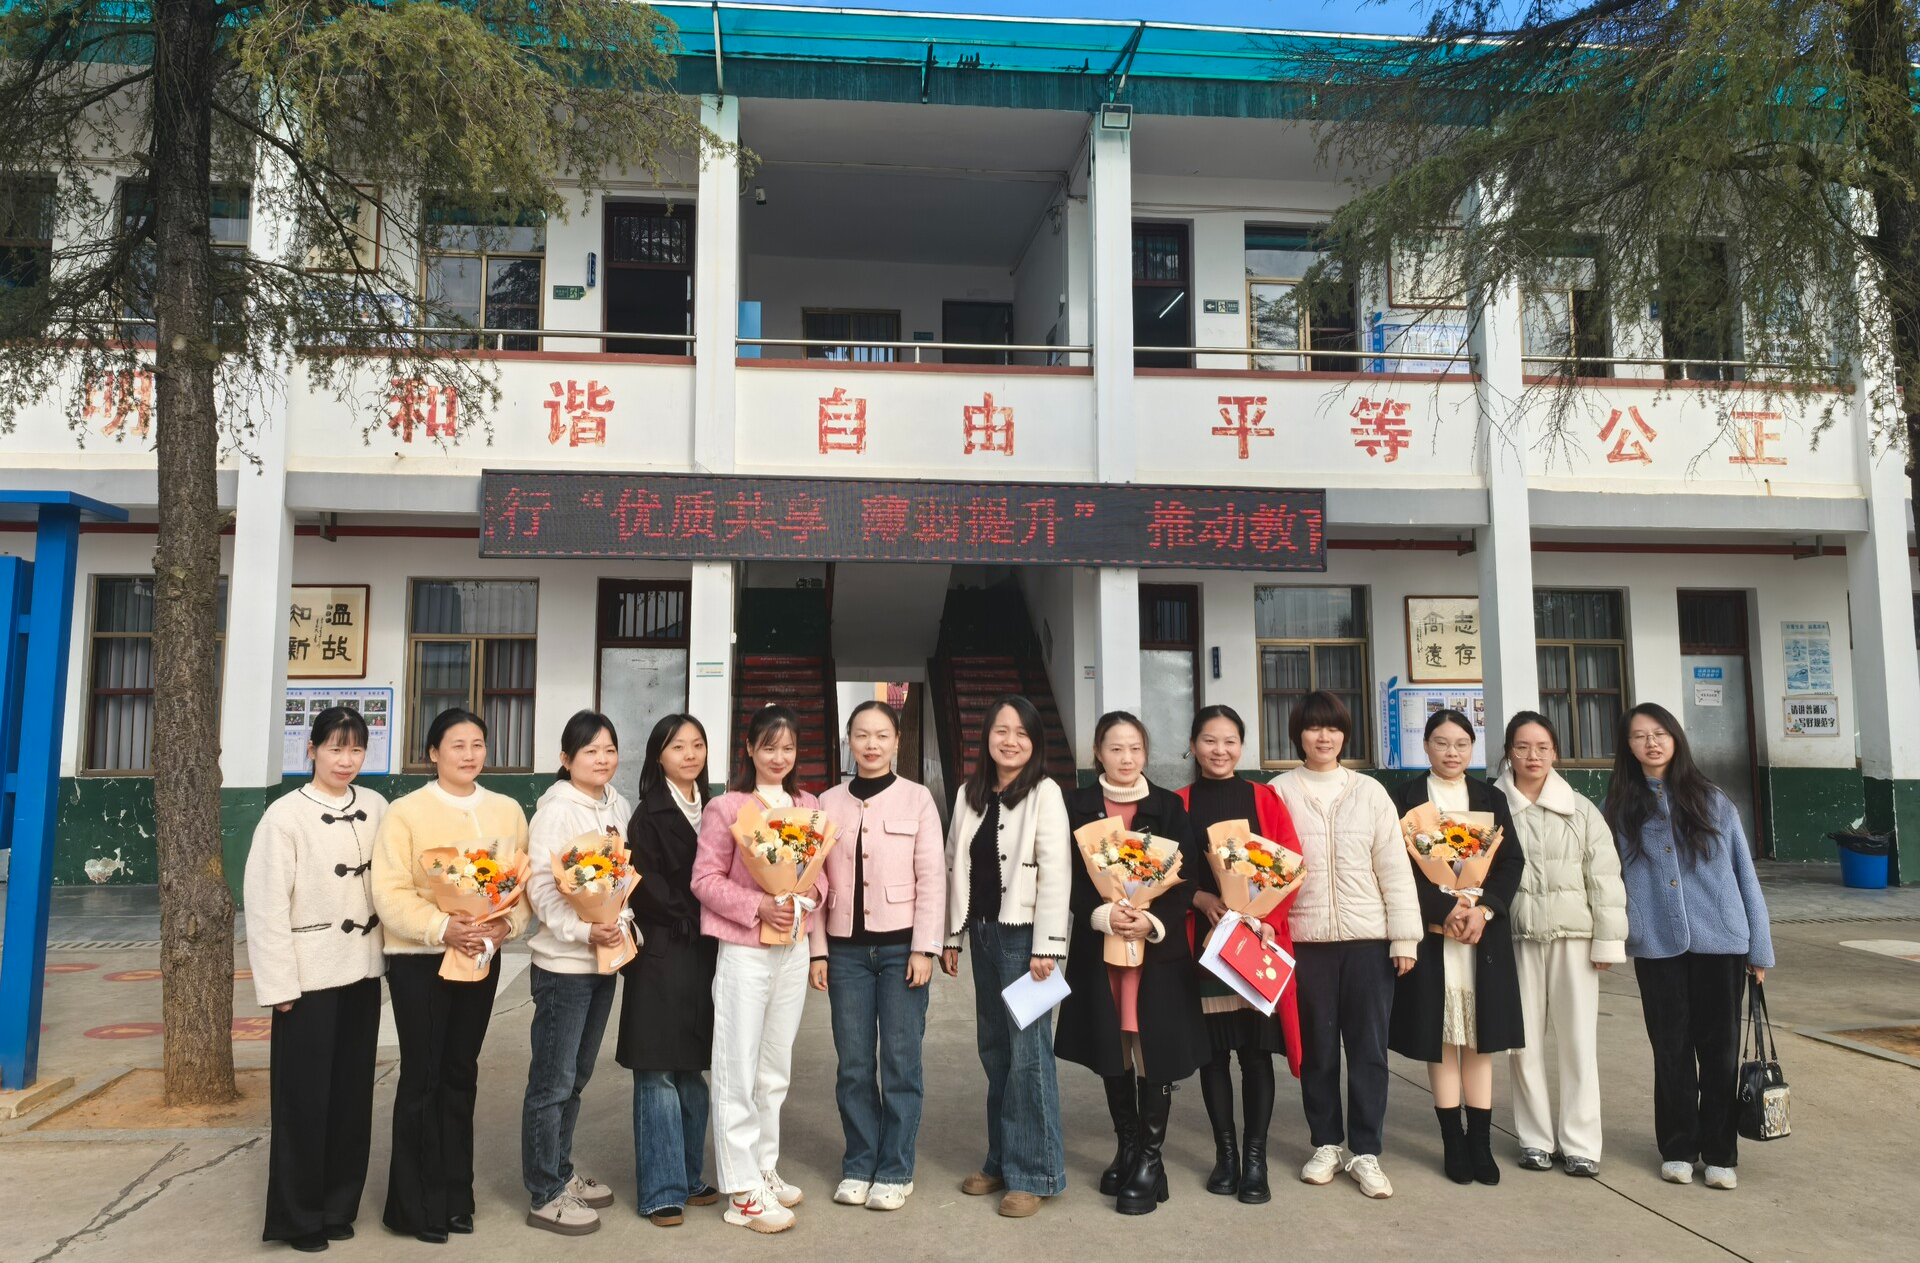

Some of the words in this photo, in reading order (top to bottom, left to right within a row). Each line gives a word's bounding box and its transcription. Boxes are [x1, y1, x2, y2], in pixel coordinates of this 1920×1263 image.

[388, 378, 615, 447] 和谐
[818, 387, 1014, 456] 自由
[1211, 396, 1412, 463] 平等
[1597, 405, 1787, 466] 公正
[1790, 704, 1828, 715] 请讲普通话
[1798, 717, 1835, 728] 写好规范字
